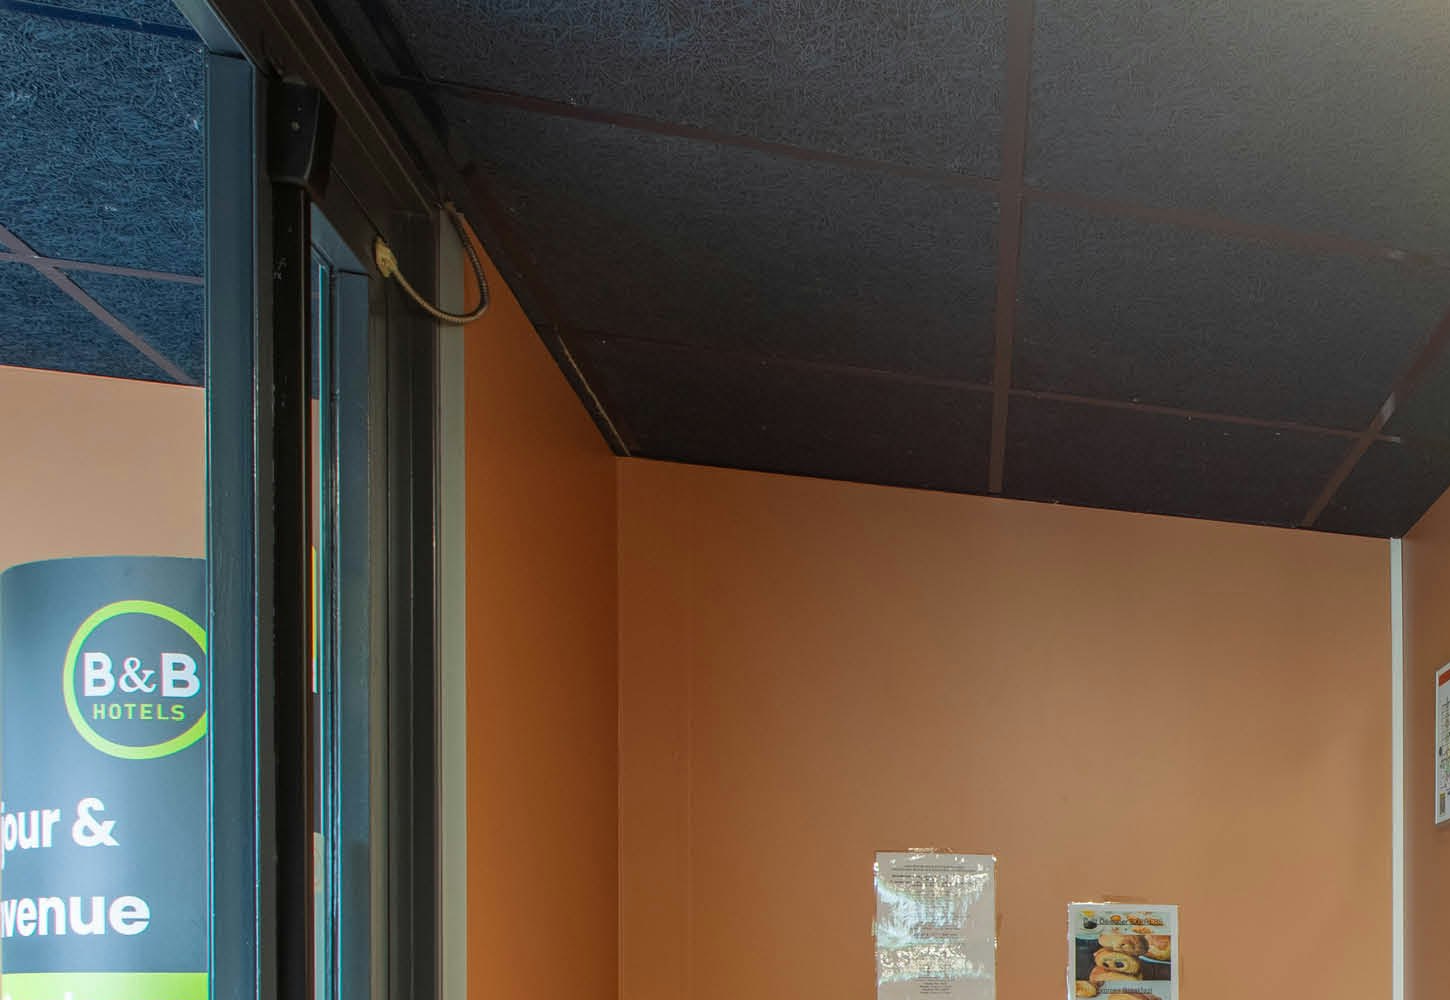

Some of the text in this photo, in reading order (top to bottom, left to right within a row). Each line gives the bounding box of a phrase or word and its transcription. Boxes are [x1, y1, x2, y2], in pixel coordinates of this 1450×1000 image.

[83, 651, 200, 698] B&B
[93, 703, 185, 721] HOTELS
[72, 797, 120, 847] &
